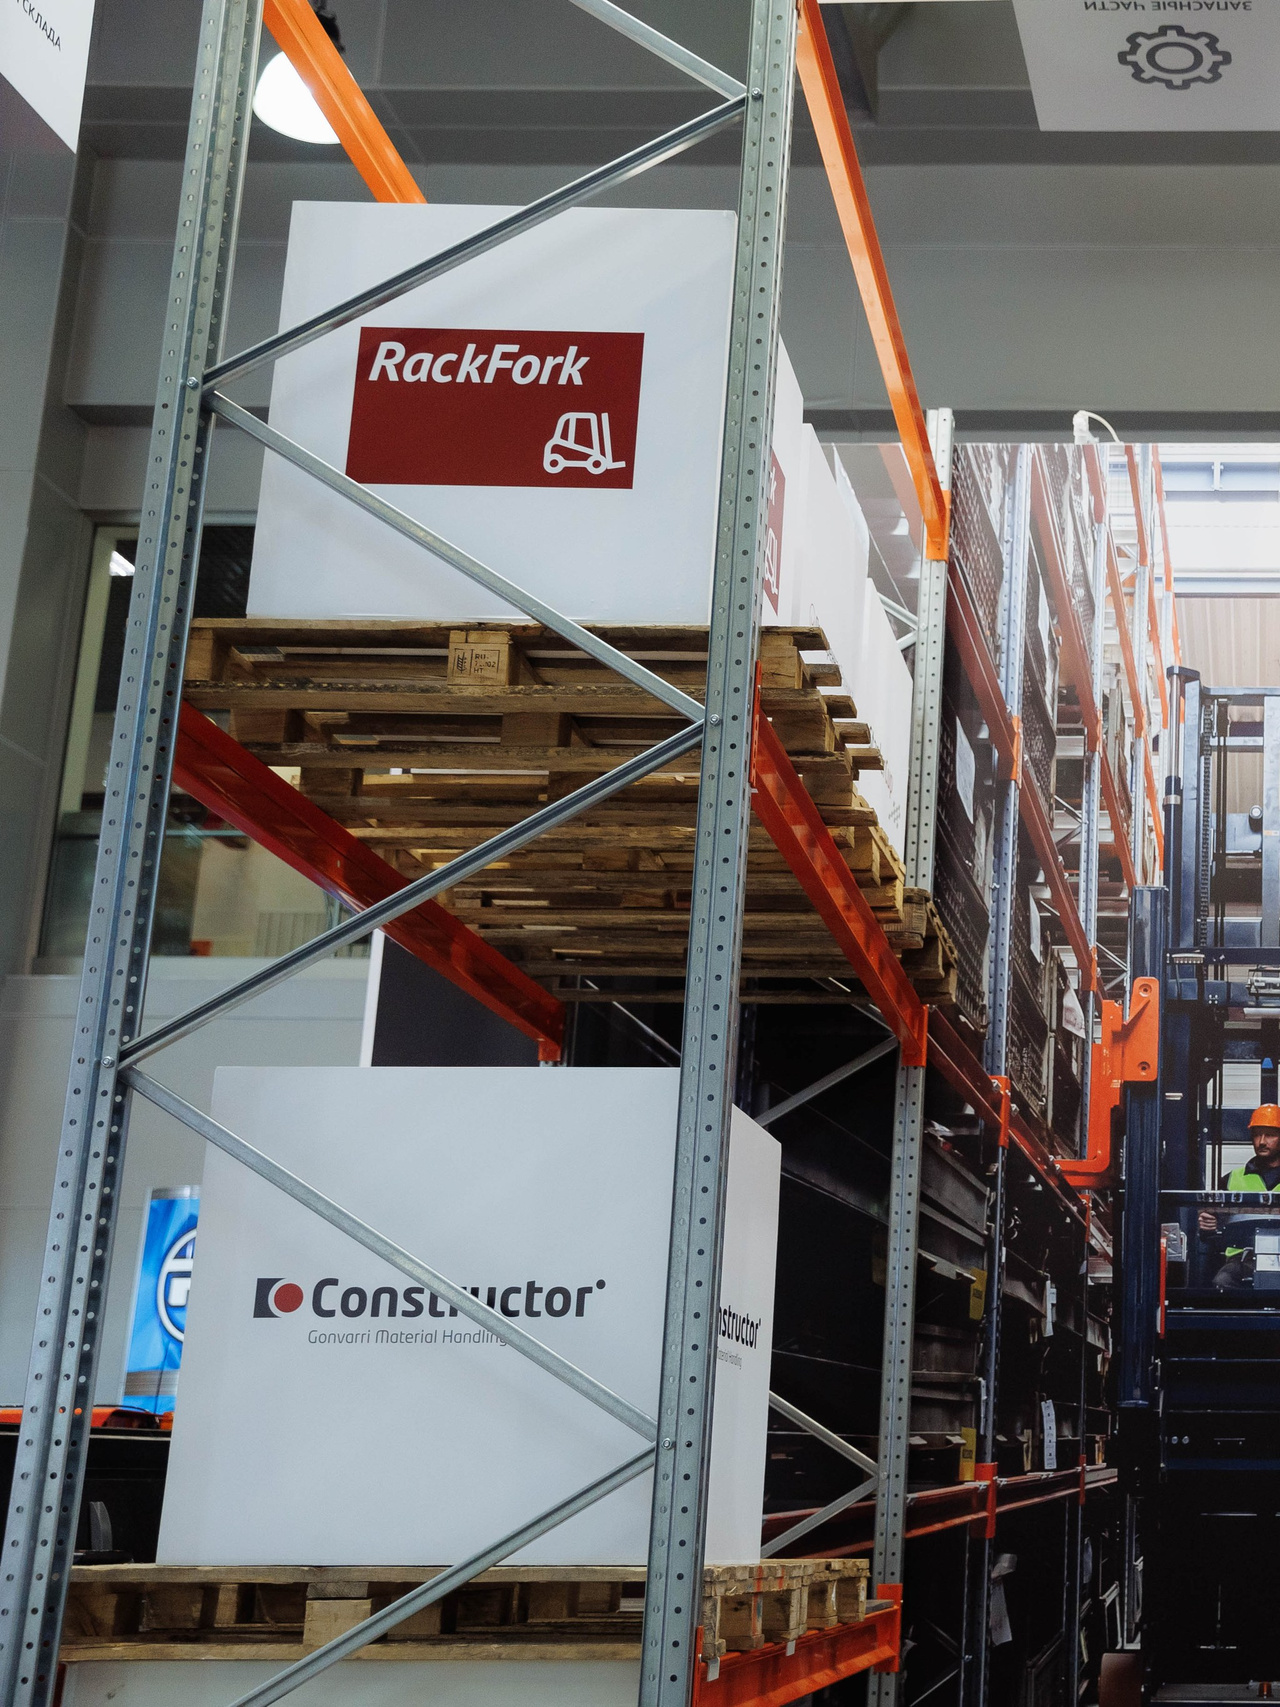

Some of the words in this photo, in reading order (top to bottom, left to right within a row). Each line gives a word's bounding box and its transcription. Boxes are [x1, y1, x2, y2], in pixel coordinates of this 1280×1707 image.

[1084, 1, 1146, 11] ЧАСТИ
[1152, 1, 1252, 11] ЗАПАСНЫЕ
[368, 341, 590, 385] RackFork
[308, 1329, 371, 1344] Gonvarri
[375, 1329, 438, 1344] Material
